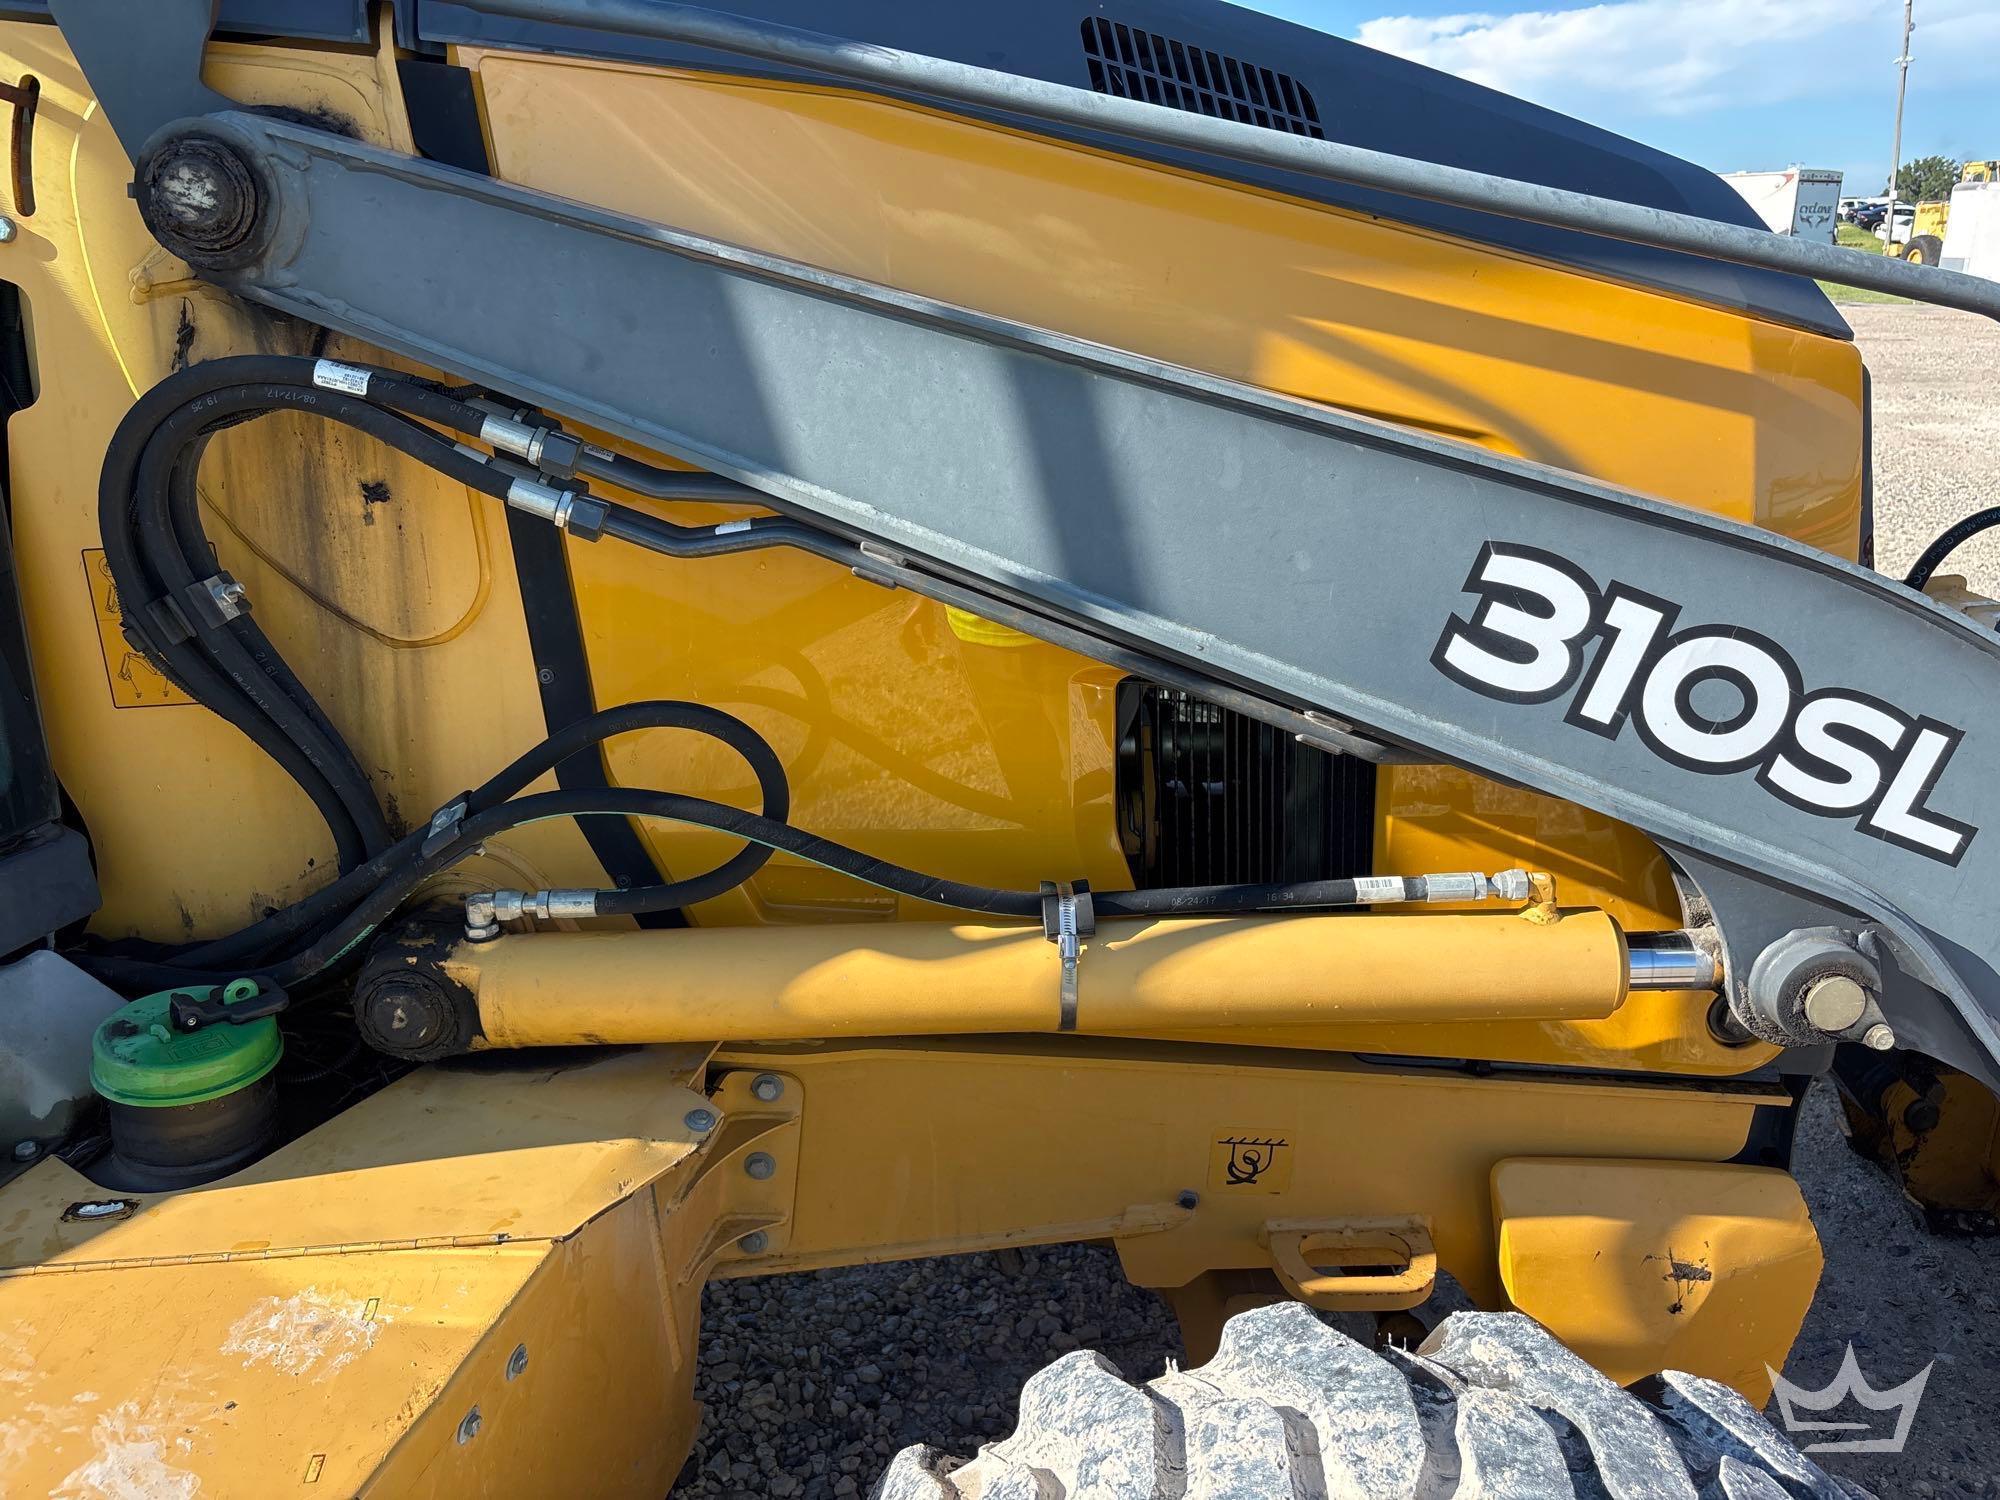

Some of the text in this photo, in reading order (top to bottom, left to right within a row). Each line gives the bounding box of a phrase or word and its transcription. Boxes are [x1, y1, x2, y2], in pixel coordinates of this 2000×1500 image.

[1929, 535, 1955, 560] Global
[1433, 542, 1976, 865] 310SL
[1144, 899, 1150, 908] J
[1171, 895, 1217, 906] 08/24/17
[1238, 895, 1243, 903] J
[1317, 890, 1323, 899] J
